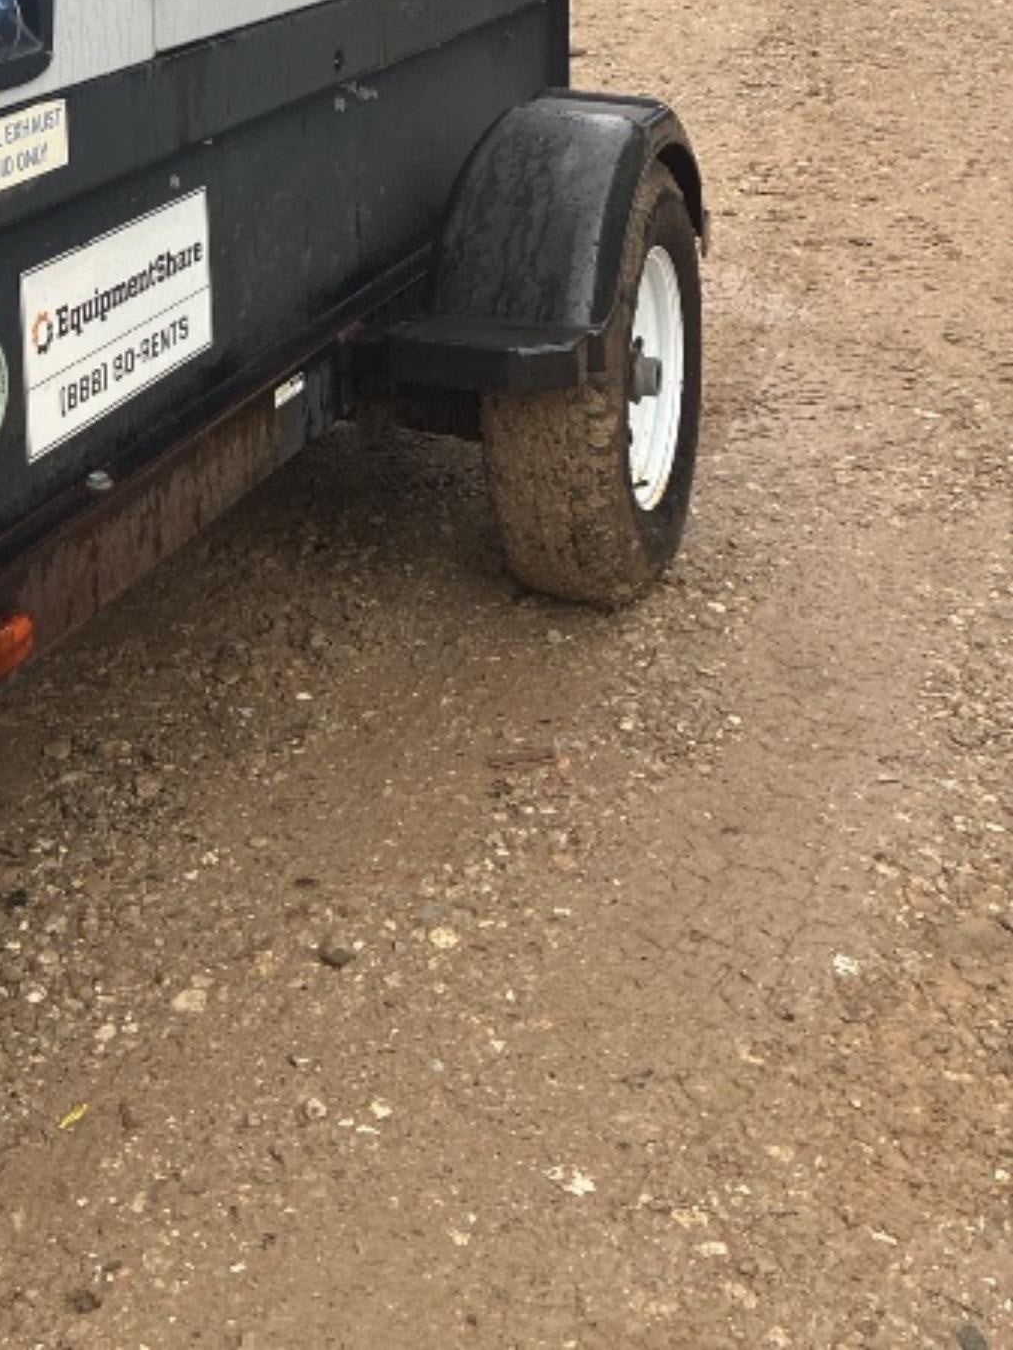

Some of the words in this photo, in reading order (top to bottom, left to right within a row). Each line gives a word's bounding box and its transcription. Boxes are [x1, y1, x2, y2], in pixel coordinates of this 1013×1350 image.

[3, 107, 62, 145] EXHAUST
[16, 142, 48, 172] ONLY
[54, 239, 204, 338] EquipmentShare
